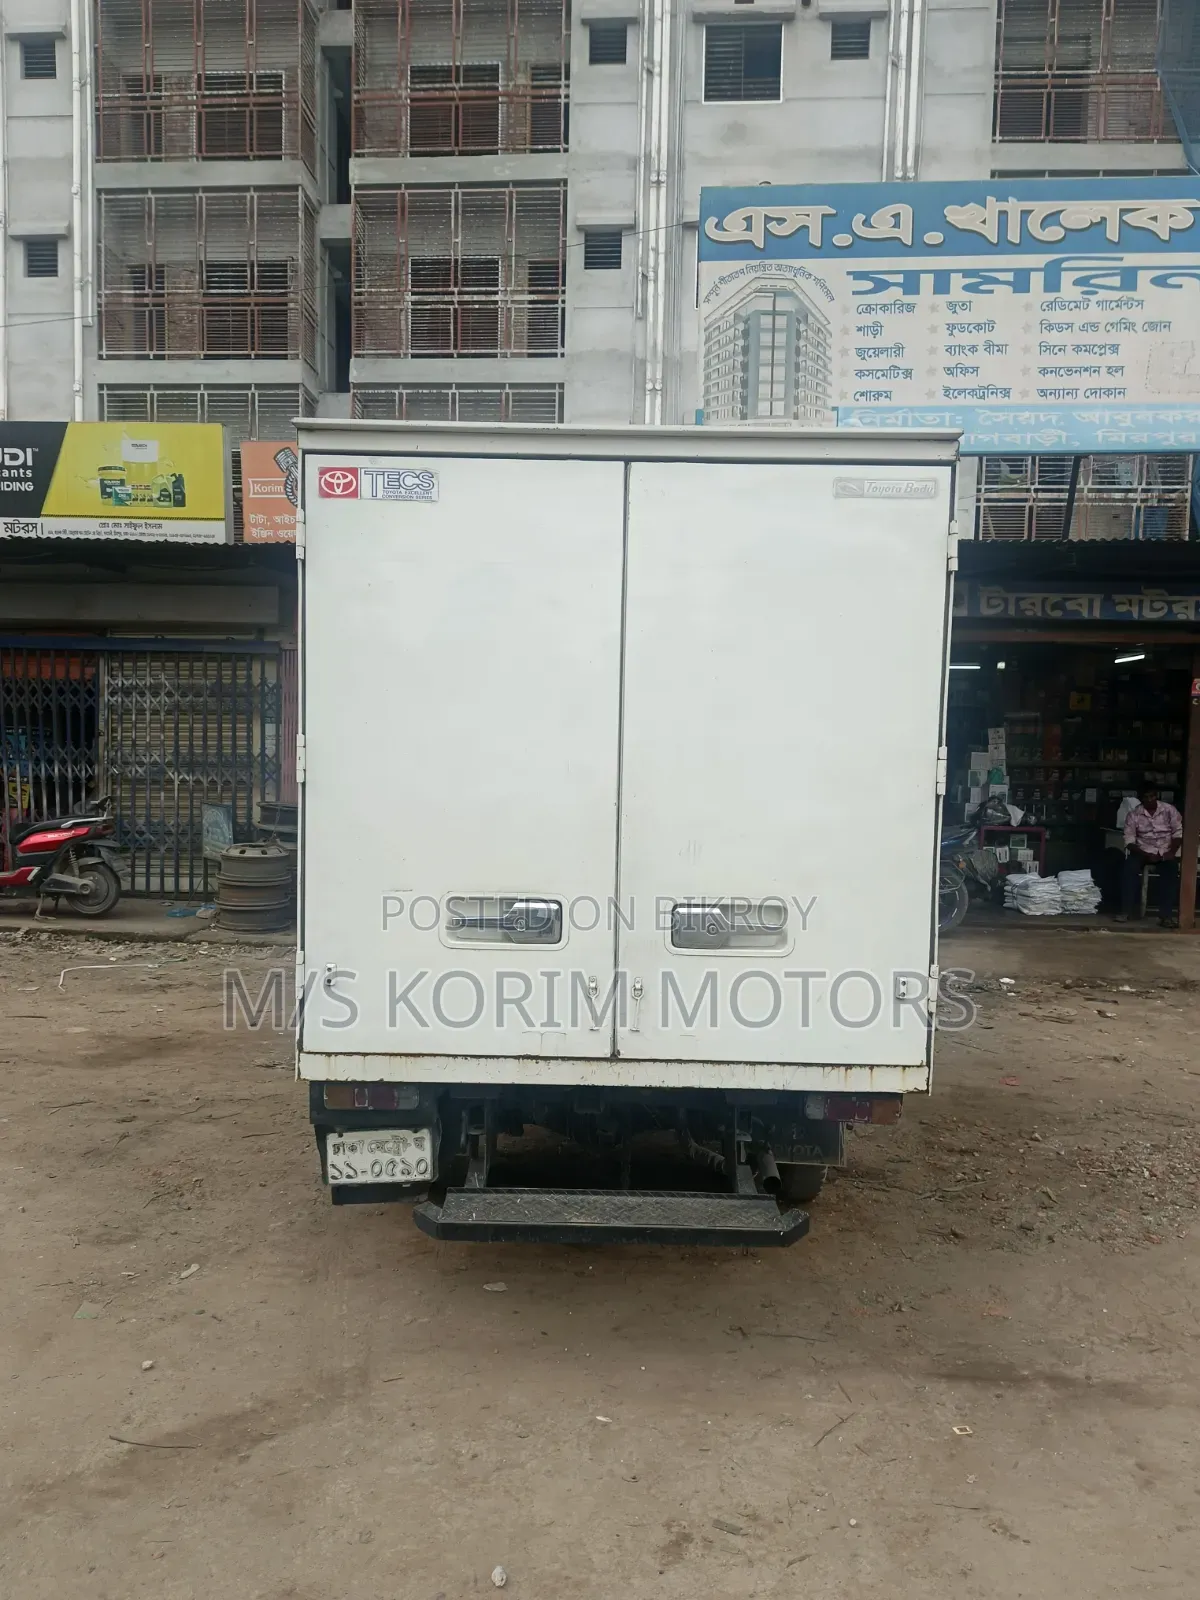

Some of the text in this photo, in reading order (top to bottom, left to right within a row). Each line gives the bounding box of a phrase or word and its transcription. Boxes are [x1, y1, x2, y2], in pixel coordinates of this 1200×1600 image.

[856, 298, 917, 315] ক্রোকারিজ
[945, 299, 973, 315] জুতা
[1040, 295, 1145, 312] রেডিমেট গার্মেন্টস
[855, 320, 885, 339] শাড়ী
[1039, 318, 1075, 334] কিডস
[1104, 317, 1138, 334] গেমিং
[1141, 319, 1172, 333] জোন
[854, 341, 906, 362] জুয়েলারী
[944, 339, 1009, 357] ব্যাংক বীমা
[1038, 340, 1067, 357] সিনে
[854, 364, 914, 381] কসমেটিক্স
[943, 362, 980, 378] অফিস
[1037, 365, 1126, 378] কনভেনশন হল
[1036, 386, 1127, 400] অন্যান্য দোকান
[0, 447, 33, 466] DI
[0, 468, 32, 478] ants
[254, 484, 284, 493] Korim
[364, 470, 435, 498] TECS
[1111, 585, 1200, 621] মটর
